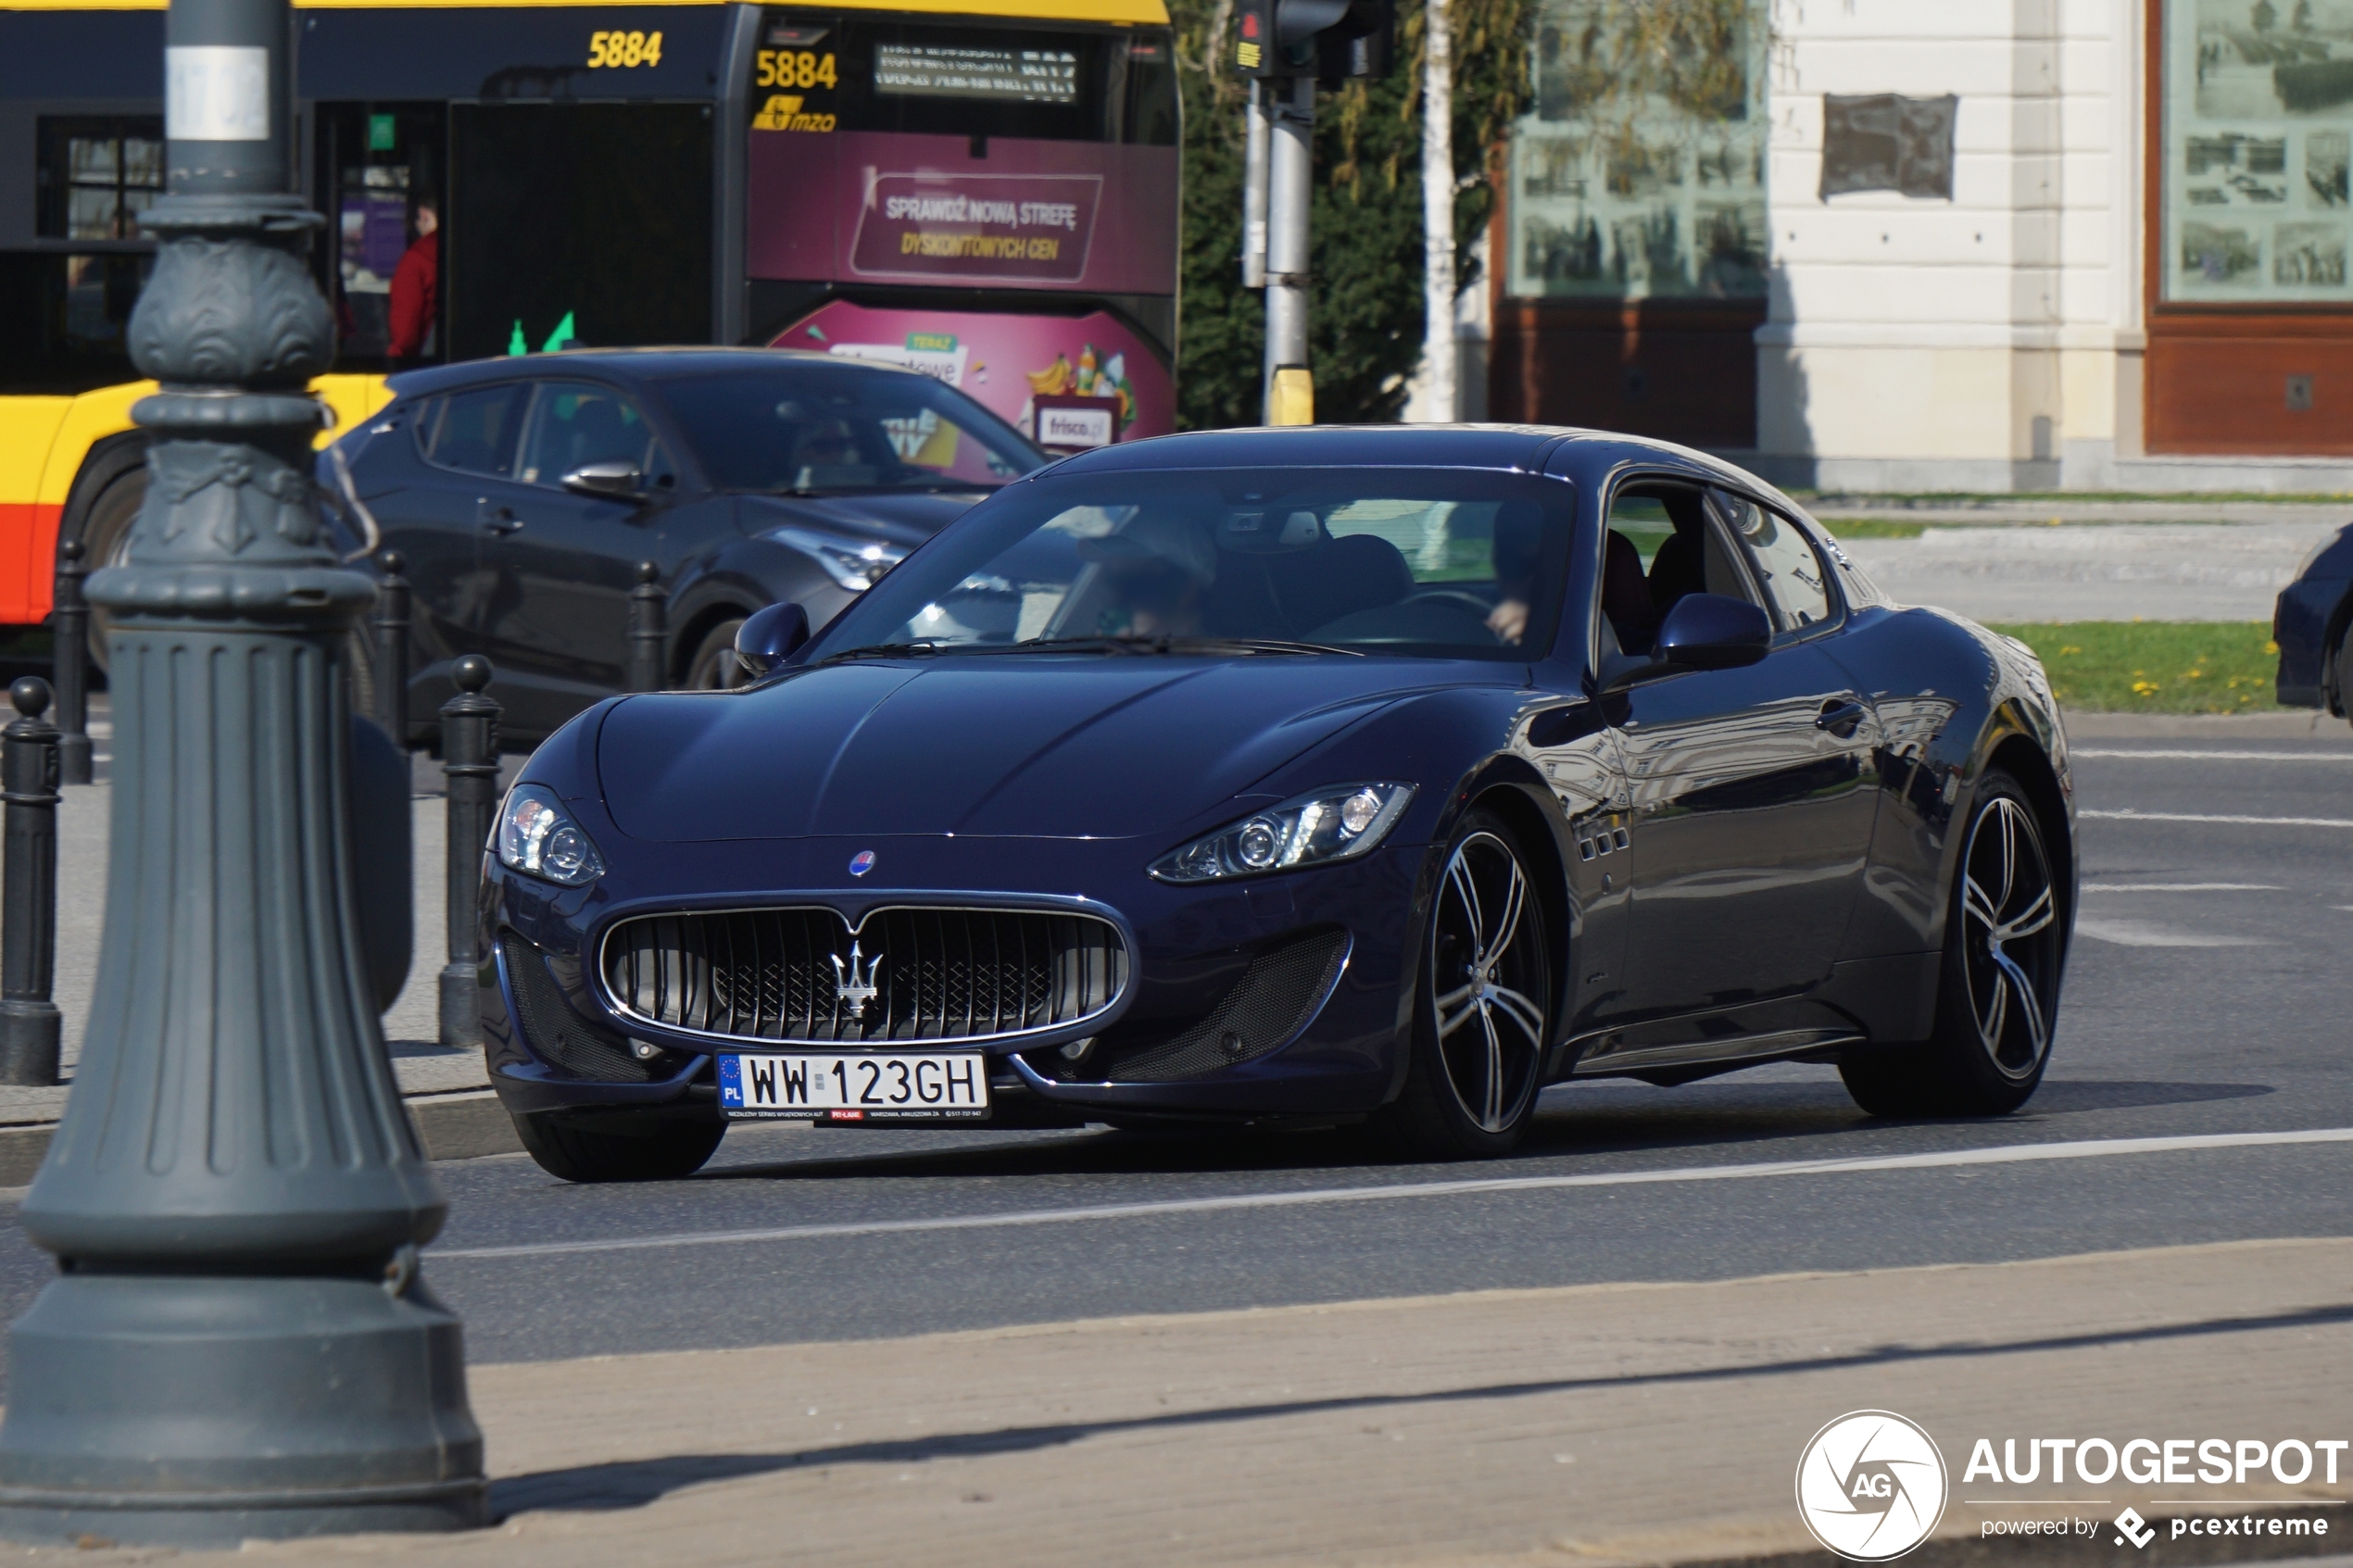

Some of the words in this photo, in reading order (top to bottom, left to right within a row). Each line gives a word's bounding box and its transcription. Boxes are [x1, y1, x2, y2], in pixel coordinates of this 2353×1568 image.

[587, 31, 664, 69] 5884
[756, 49, 838, 90] 5884
[969, 199, 1018, 230] NOWĄ
[1019, 202, 1077, 231] STREFĘ
[901, 232, 1026, 259] DYSKONTOWYCH
[1028, 237, 1060, 260] CEN
[724, 1087, 742, 1100] PL
[749, 1059, 809, 1105] WW
[832, 1059, 976, 1105] 123GH
